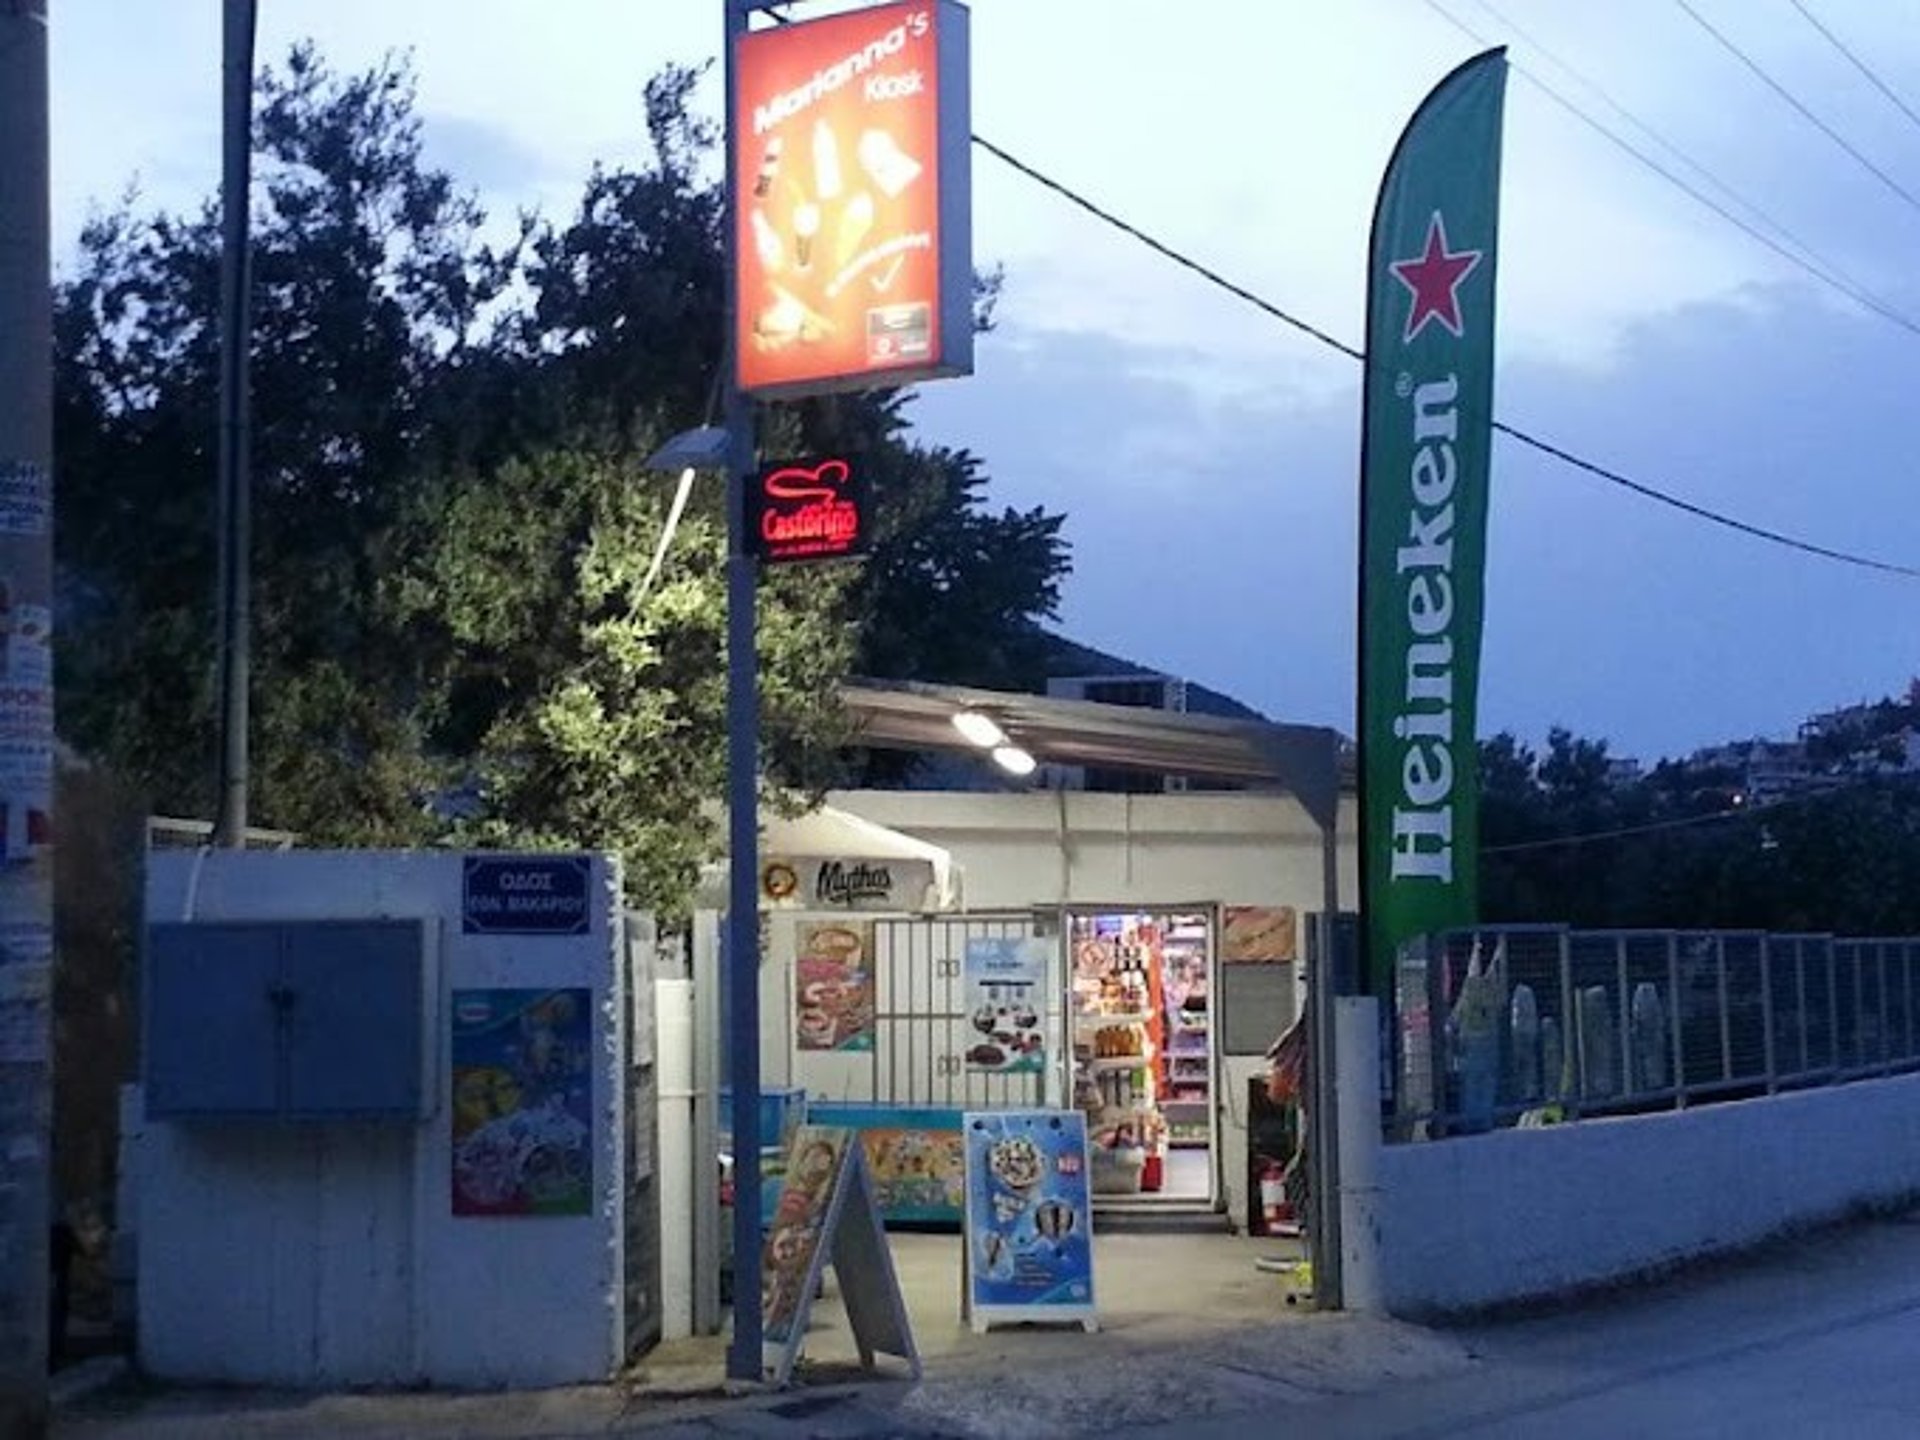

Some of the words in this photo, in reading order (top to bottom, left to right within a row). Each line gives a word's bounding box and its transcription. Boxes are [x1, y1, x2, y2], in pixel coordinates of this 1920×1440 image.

[753, 11, 929, 135] Marianna's
[865, 69, 924, 102] Kiosk
[1389, 371, 1459, 884] Heineken
[816, 861, 892, 906] Mythos
